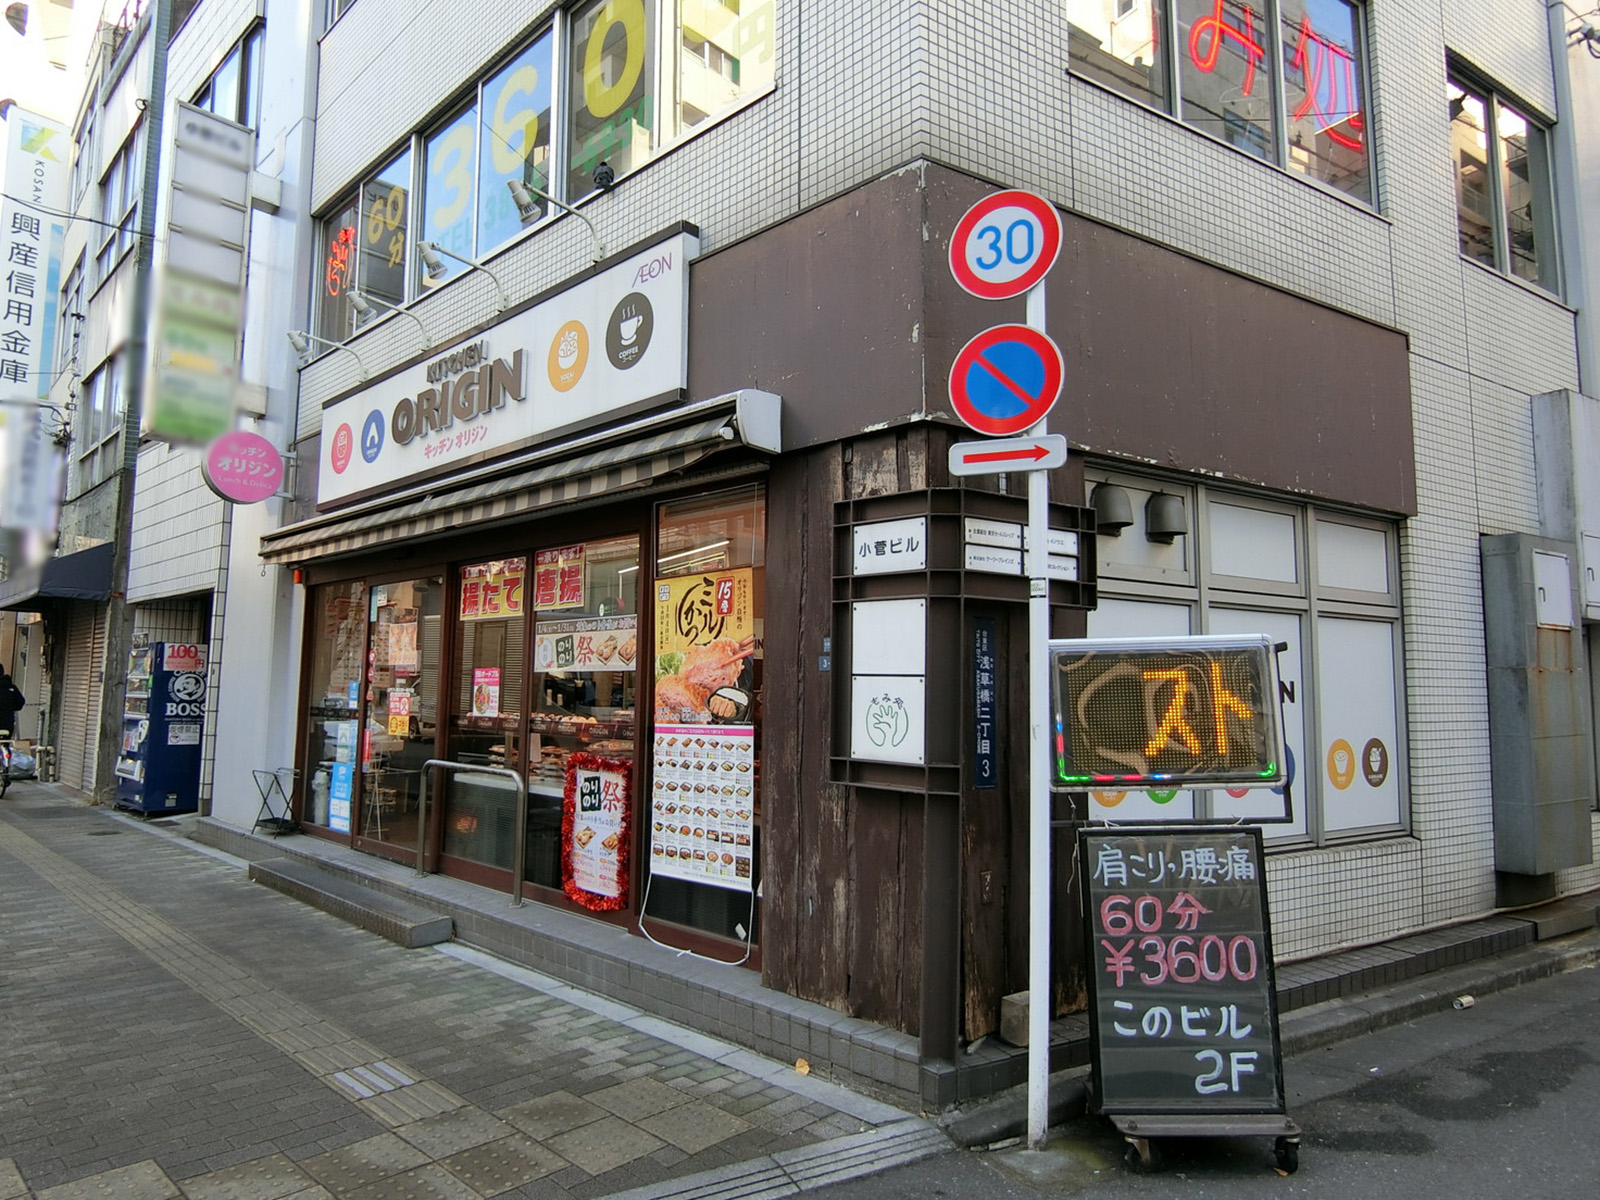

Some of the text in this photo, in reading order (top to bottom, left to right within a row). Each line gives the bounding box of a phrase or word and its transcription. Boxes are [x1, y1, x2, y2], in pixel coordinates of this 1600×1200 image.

[32, 159, 46, 205] KOSAN
[975, 218, 1034, 271] 30
[0, 212, 41, 384] 興産信用金庫
[426, 339, 489, 384] KITCHEN
[618, 345, 640, 360] COFFEE
[391, 347, 529, 446] ORIGIN
[424, 424, 488, 459] キッチン オリジン
[217, 457, 277, 478] オリジン
[858, 536, 920, 558] 小菅ビル
[575, 635, 595, 667] 祭
[164, 702, 206, 717] BOSS
[1143, 661, 1253, 757] スト
[982, 758, 990, 778] 3
[601, 779, 621, 813] 祭
[1100, 891, 1214, 936] 60分
[1101, 935, 1258, 988] ¥3600
[1112, 1000, 1252, 1039] このビル
[1194, 1049, 1259, 1095] 2F
